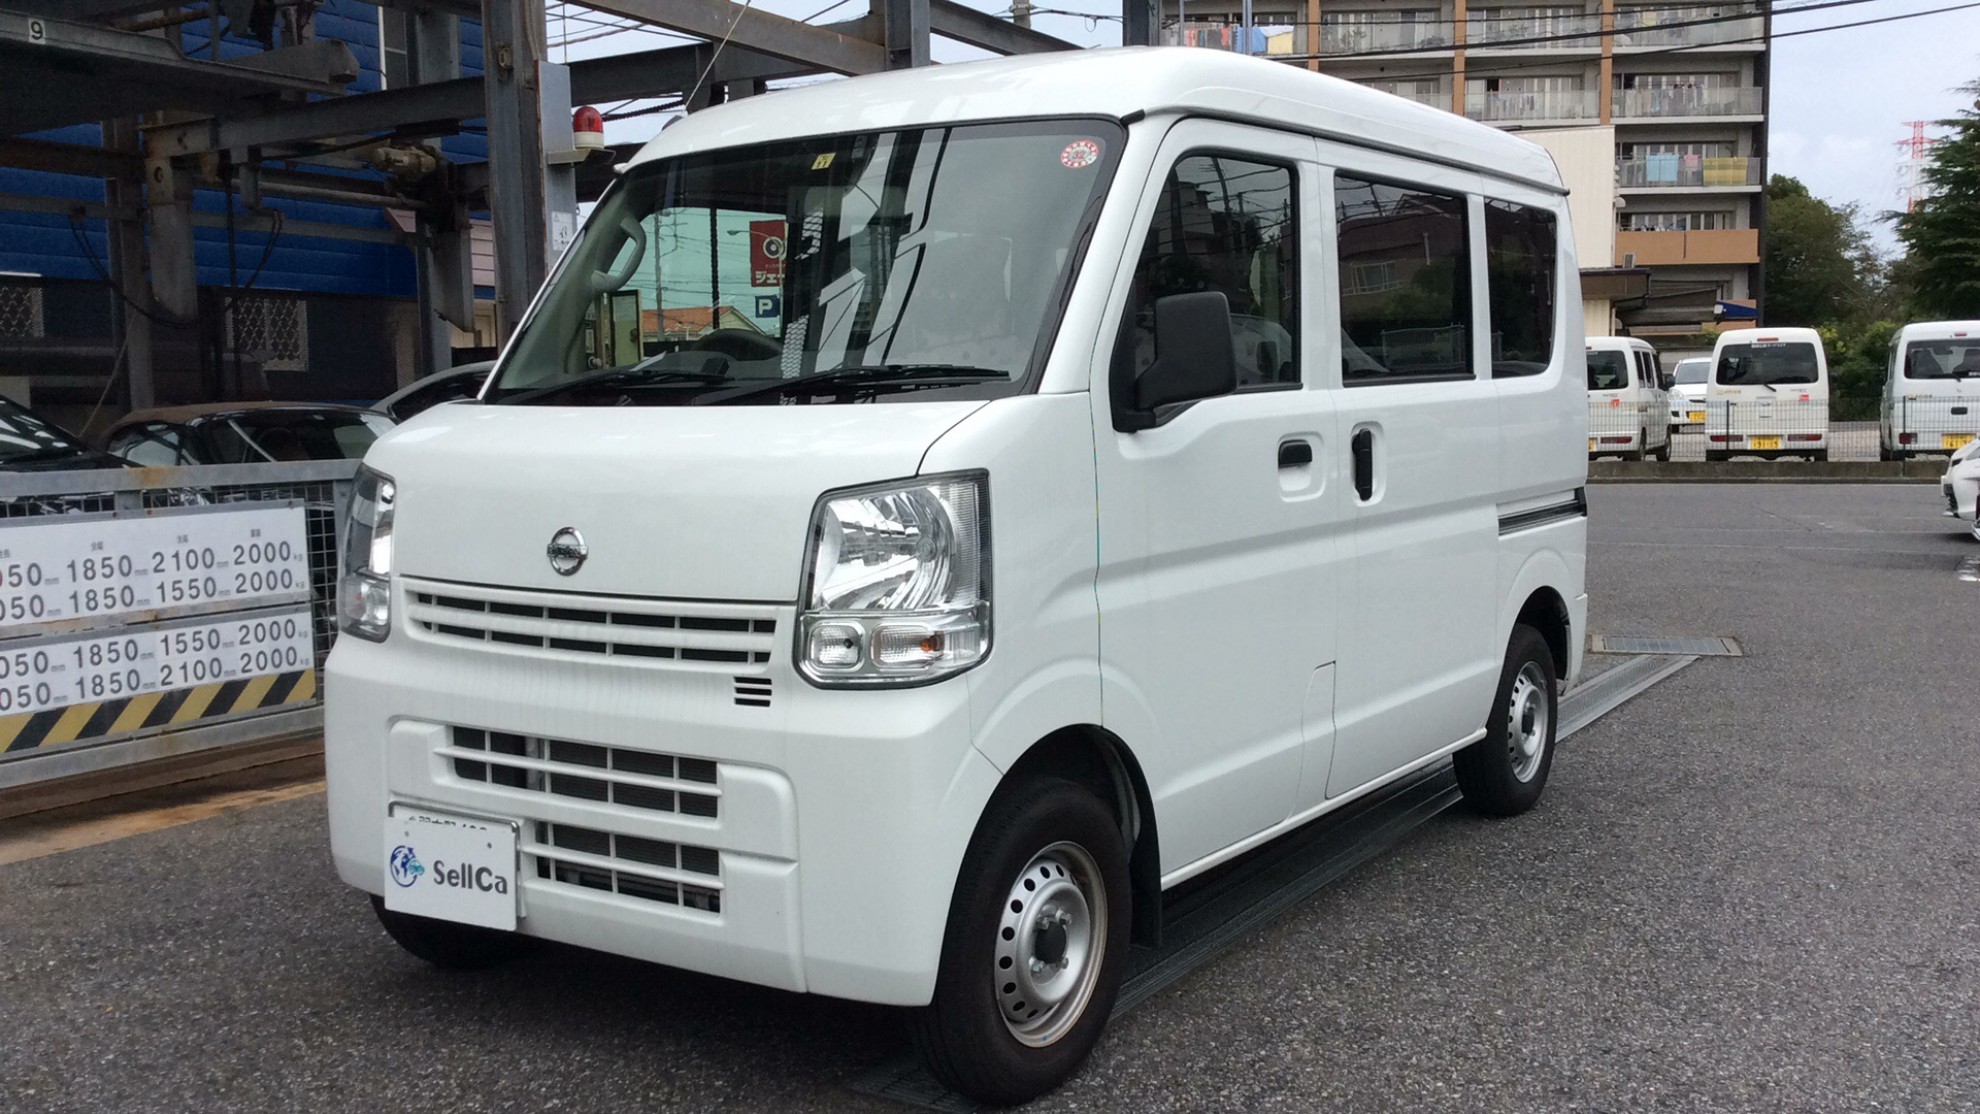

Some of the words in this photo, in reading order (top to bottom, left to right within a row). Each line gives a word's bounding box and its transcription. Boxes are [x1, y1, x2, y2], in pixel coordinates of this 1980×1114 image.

[31, 21, 43, 40] 9
[758, 298, 773, 315] P
[0, 563, 42, 588] 50
[67, 555, 132, 583] 1850
[152, 547, 215, 574] 2100
[233, 541, 291, 566] 2000
[69, 585, 135, 614] 1850
[156, 576, 217, 603] 1550
[235, 568, 293, 594] 2000
[73, 639, 138, 669] 1850
[160, 628, 220, 656] 1550
[239, 618, 296, 646] 2000
[75, 669, 140, 699] 1850
[160, 657, 222, 686] 2100
[240, 646, 297, 673] 2000
[433, 860, 508, 894] SellCa
